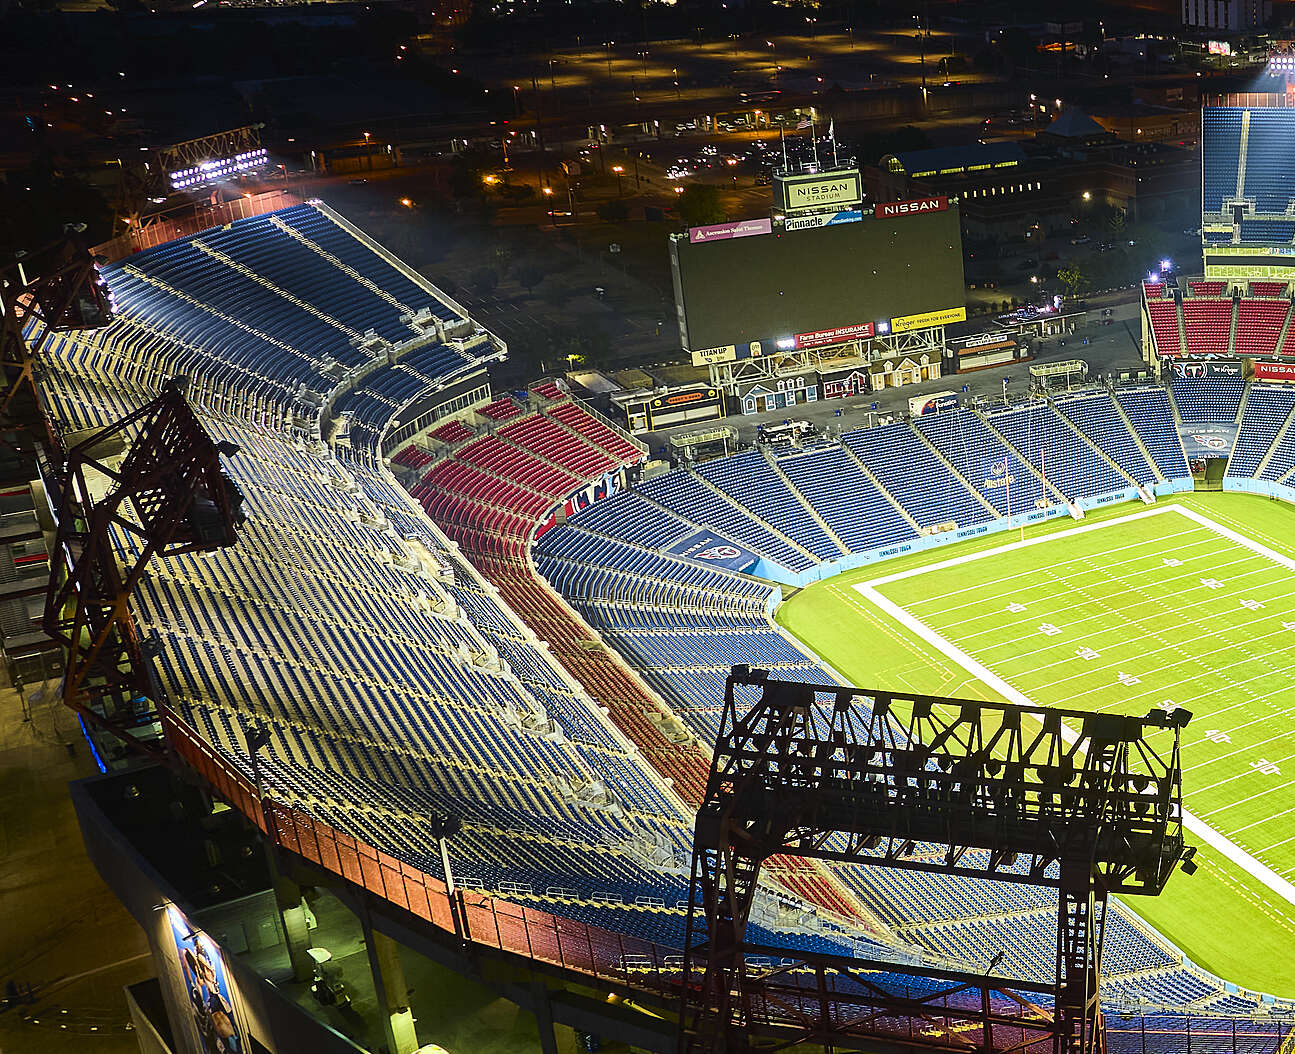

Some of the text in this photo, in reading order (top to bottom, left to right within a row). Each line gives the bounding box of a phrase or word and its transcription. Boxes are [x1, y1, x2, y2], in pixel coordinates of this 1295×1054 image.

[797, 183, 848, 196] NISSAN
[806, 193, 840, 201] STADIUM
[884, 200, 939, 215] NISSAN
[786, 216, 823, 230] Pinnacle
[895, 318, 915, 330] Kroger
[799, 333, 814, 342] Farm
[835, 325, 869, 336] INSURANCE
[699, 349, 718, 358] TITAN
[718, 347, 727, 355] UP
[1220, 365, 1239, 376] Kroger
[983, 475, 1016, 489] Allstate
[1204, 729, 1229, 744] 40
[1249, 757, 1279, 776] 30
